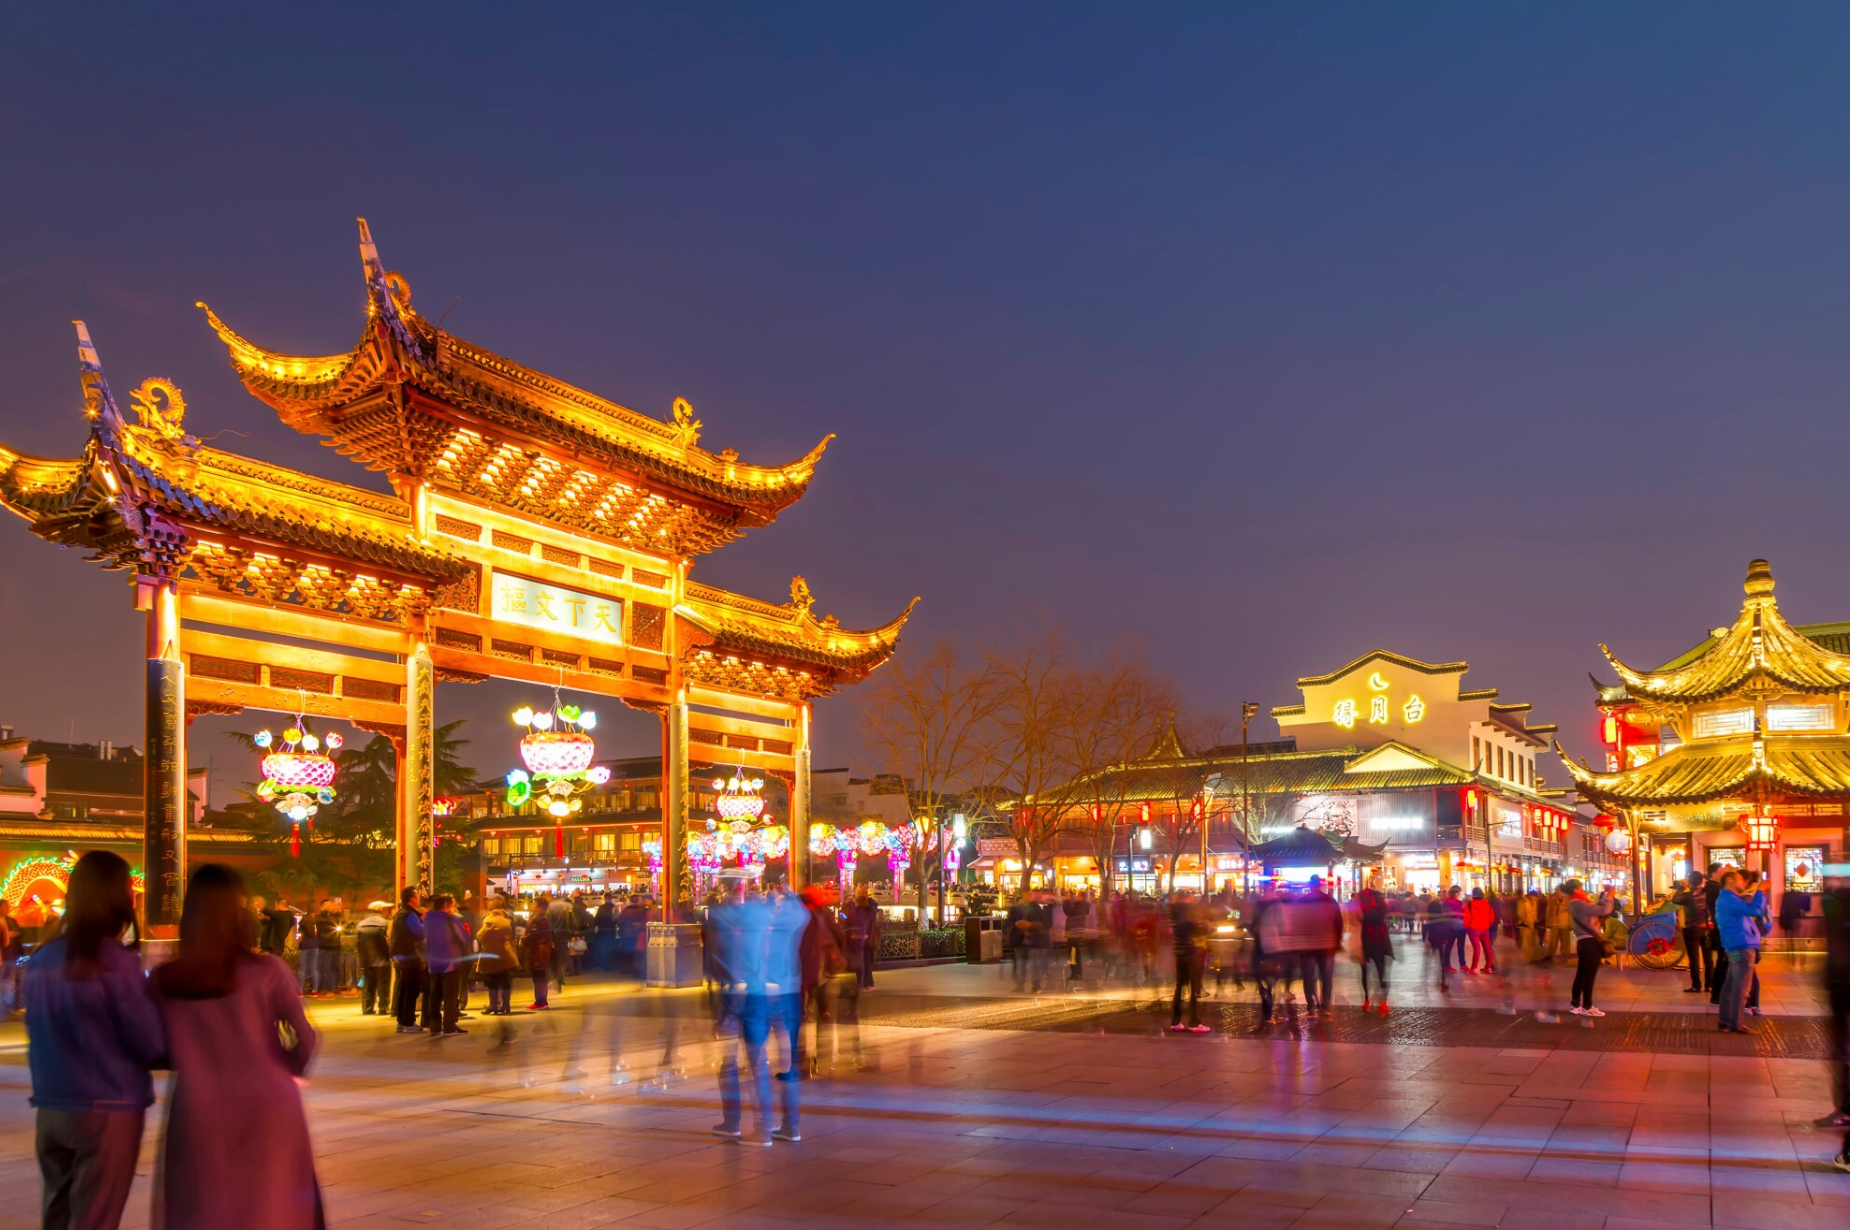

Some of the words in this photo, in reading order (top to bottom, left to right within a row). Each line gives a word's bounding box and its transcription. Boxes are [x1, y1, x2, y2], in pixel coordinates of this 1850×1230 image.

[500, 581, 617, 633] 天下文樞
[1333, 695, 1425, 729] 得月台
